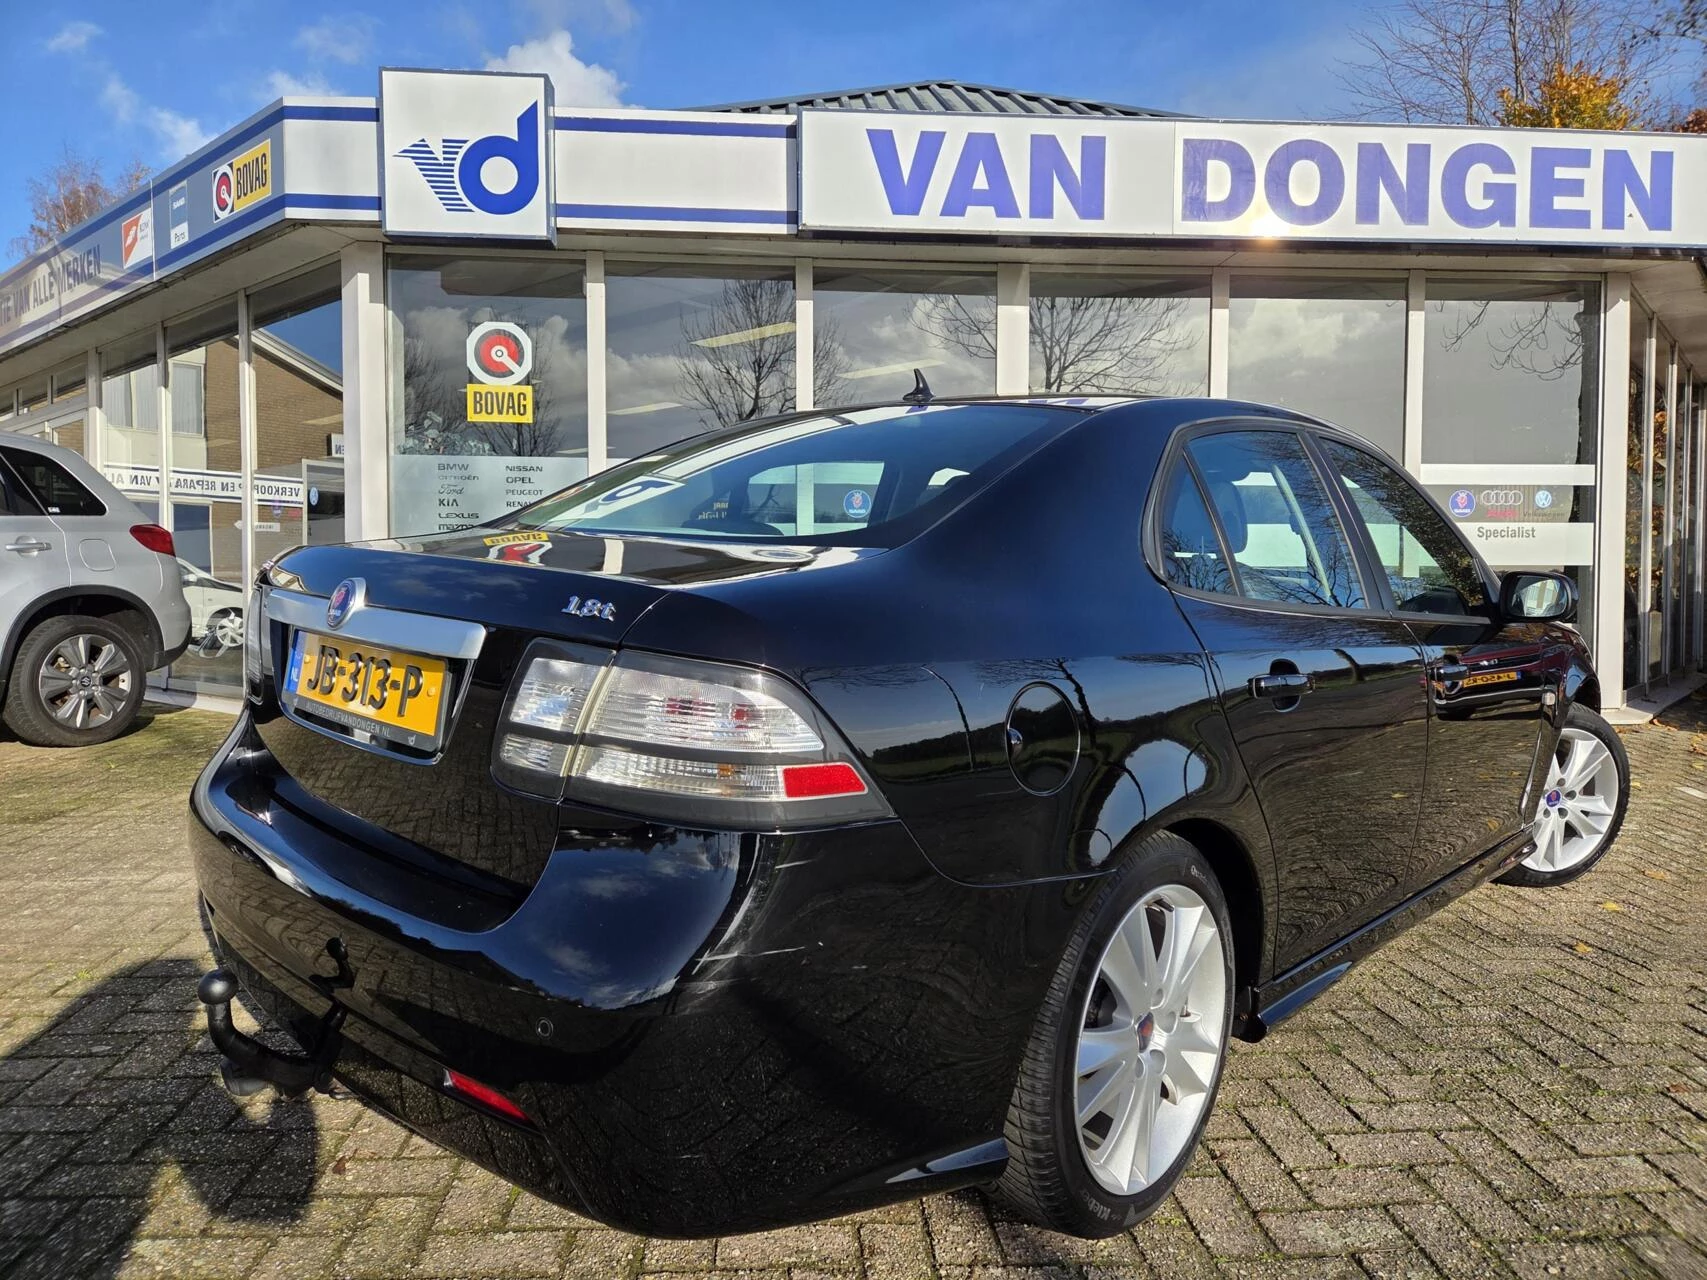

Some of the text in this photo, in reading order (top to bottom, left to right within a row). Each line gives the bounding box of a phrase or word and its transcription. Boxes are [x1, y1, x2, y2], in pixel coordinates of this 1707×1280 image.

[236, 153, 267, 200] BOVAG
[866, 128, 1674, 231] VAN DONGEN
[13, 284, 30, 318] VAN
[33, 272, 55, 309] ALLE
[60, 244, 101, 294] MERKEN
[473, 391, 527, 416] BOVAG
[437, 463, 469, 471] BMW
[438, 483, 465, 495] Ford
[505, 476, 535, 484] OPEL
[438, 498, 459, 507] KIA
[1477, 526, 1536, 541] Specialist
[307, 645, 424, 718] JB-313-P
